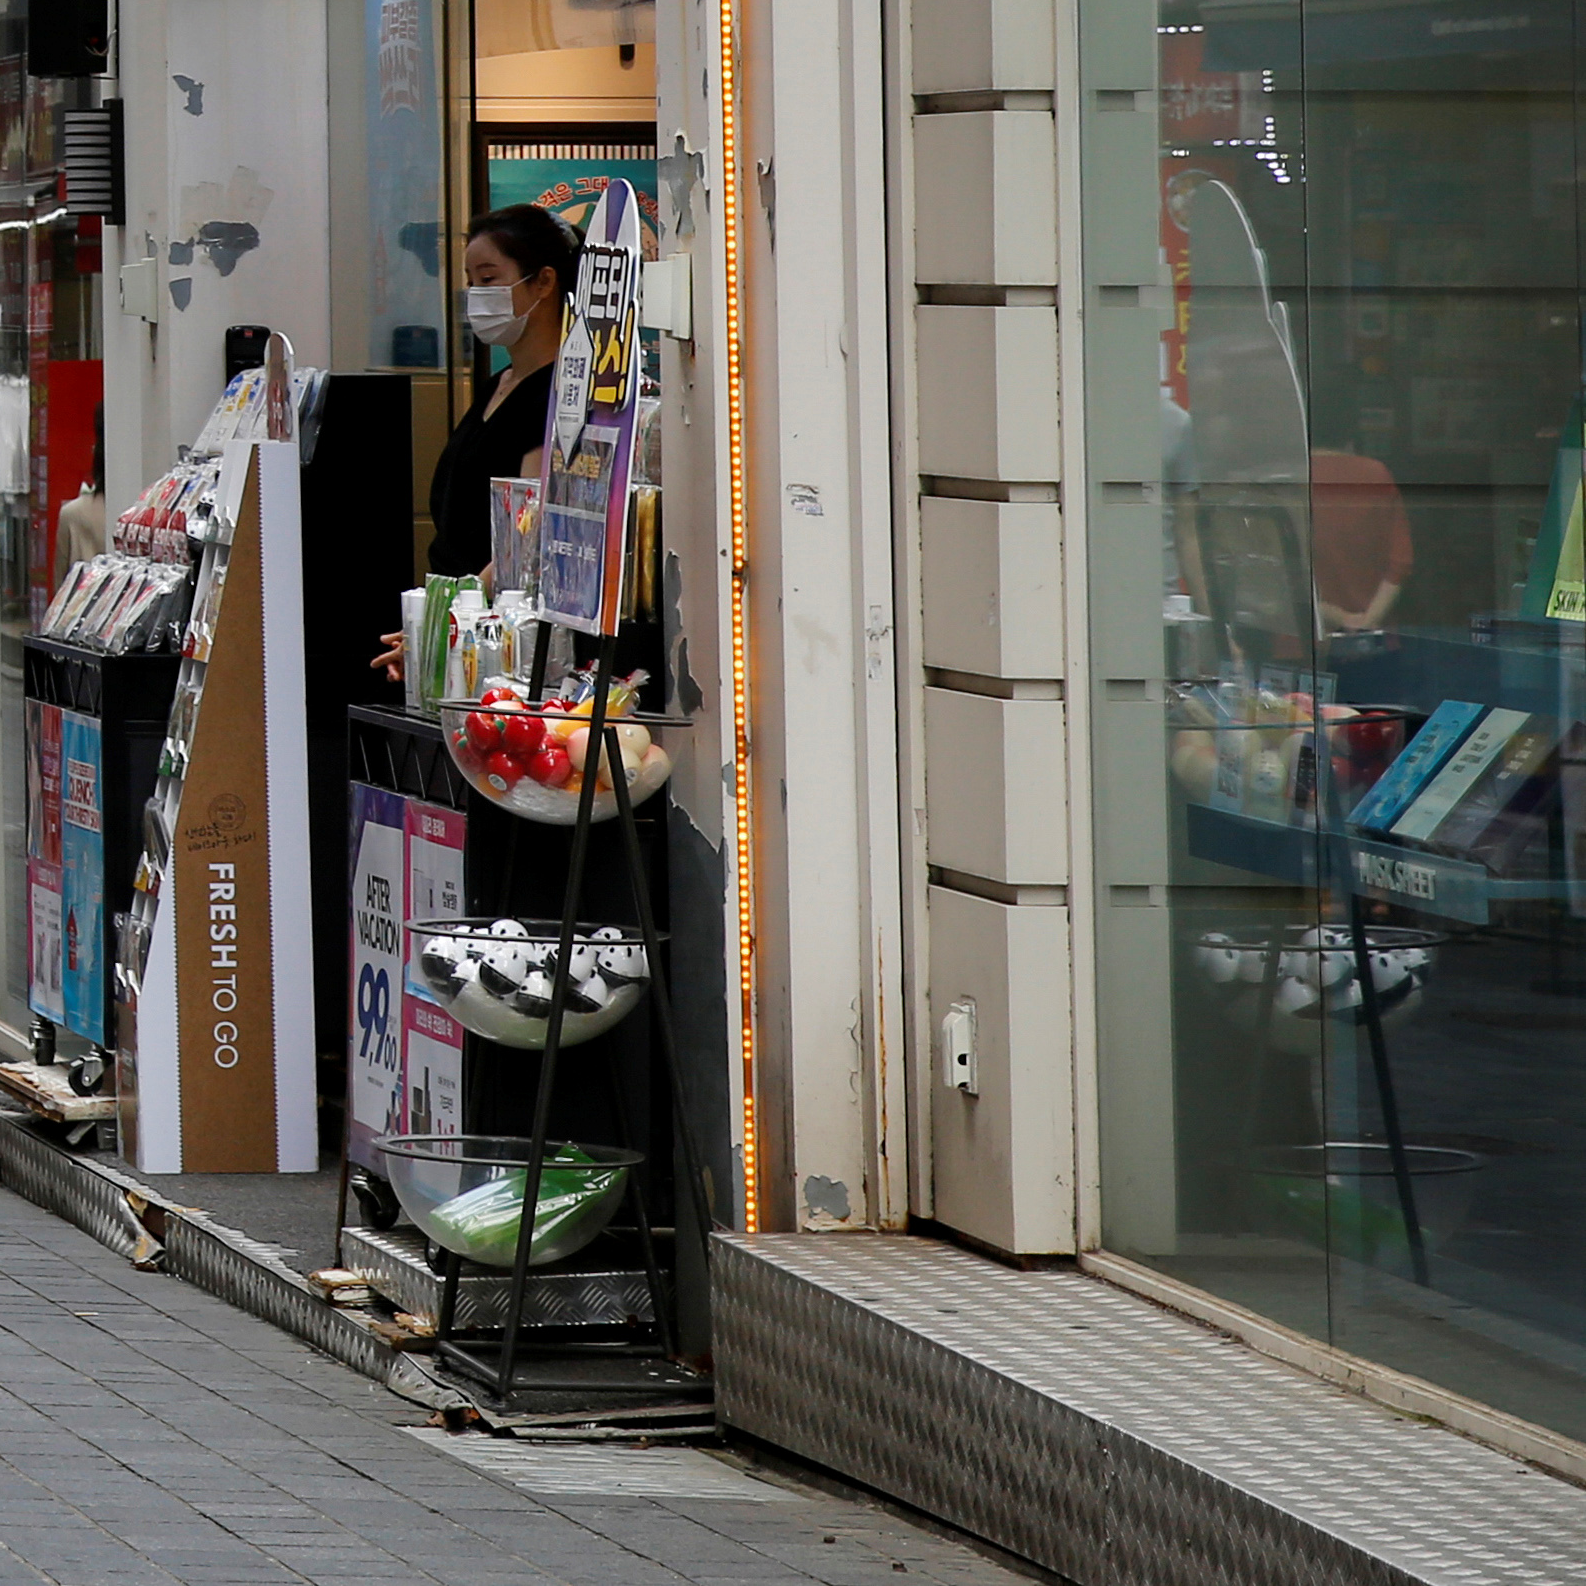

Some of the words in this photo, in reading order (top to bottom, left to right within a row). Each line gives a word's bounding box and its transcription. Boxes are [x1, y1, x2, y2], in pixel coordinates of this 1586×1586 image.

[208, 862, 238, 968] FRESH
[365, 873, 392, 915] AFTER
[357, 909, 400, 959] VACATION
[212, 973, 238, 1012] TO
[213, 1020, 239, 1070] GO
